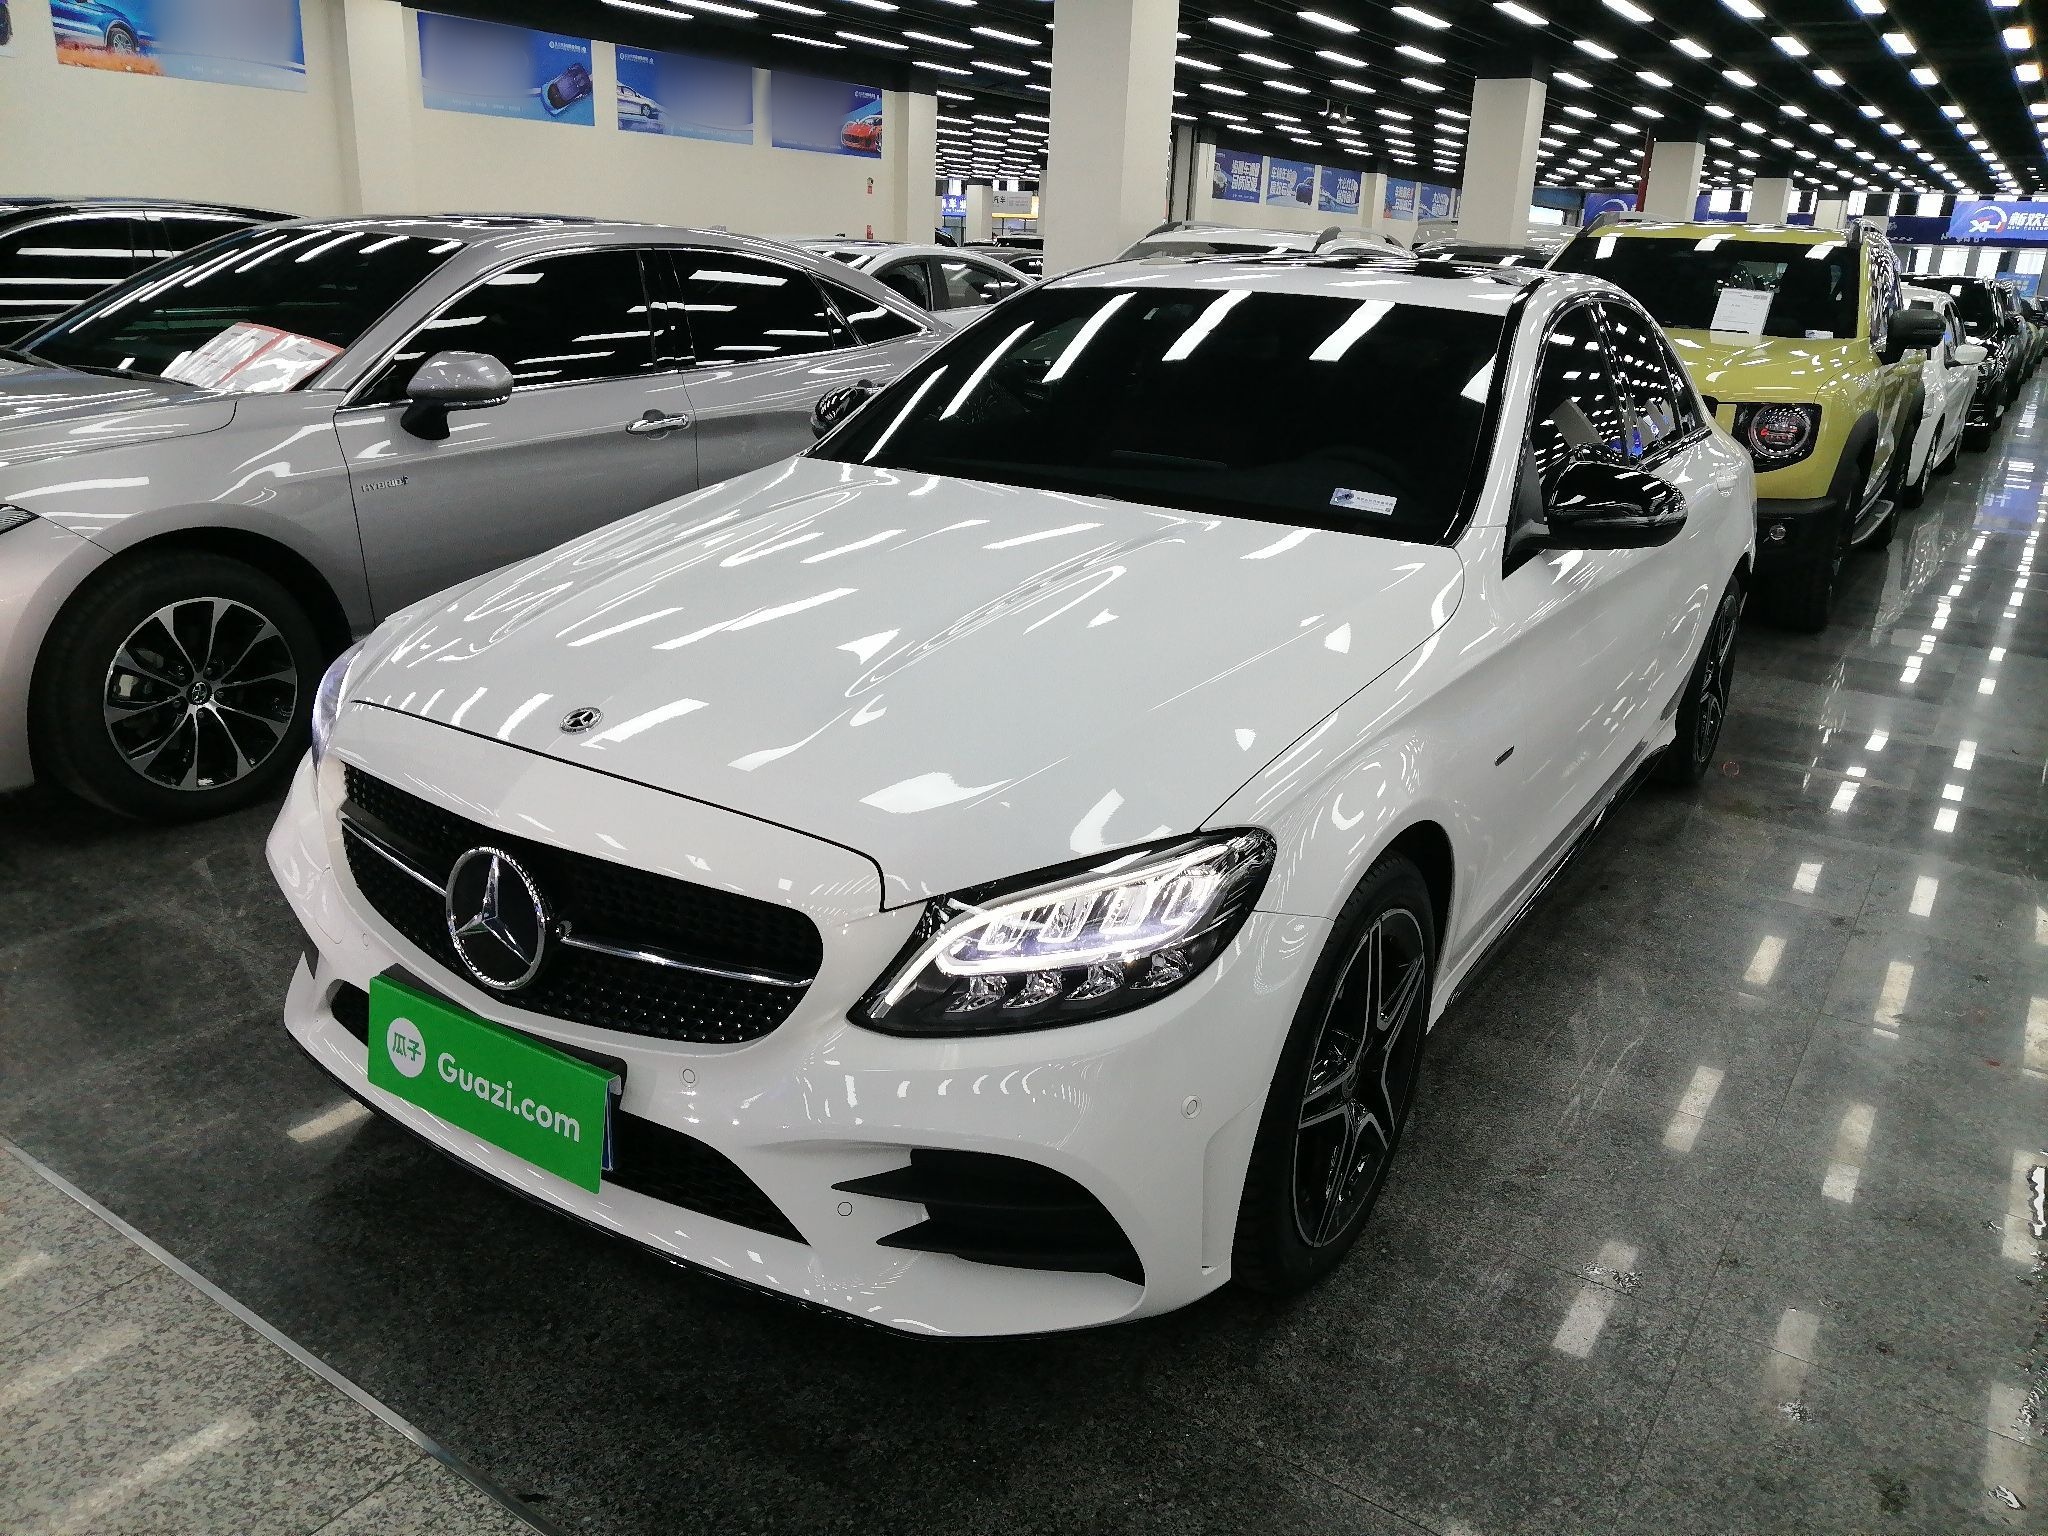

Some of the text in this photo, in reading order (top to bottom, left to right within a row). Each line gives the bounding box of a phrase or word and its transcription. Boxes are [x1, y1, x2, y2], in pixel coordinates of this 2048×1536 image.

[361, 479, 404, 493] HYBRID
[392, 1031, 422, 1062] 瓜子
[437, 1052, 581, 1143] Guazi.com
